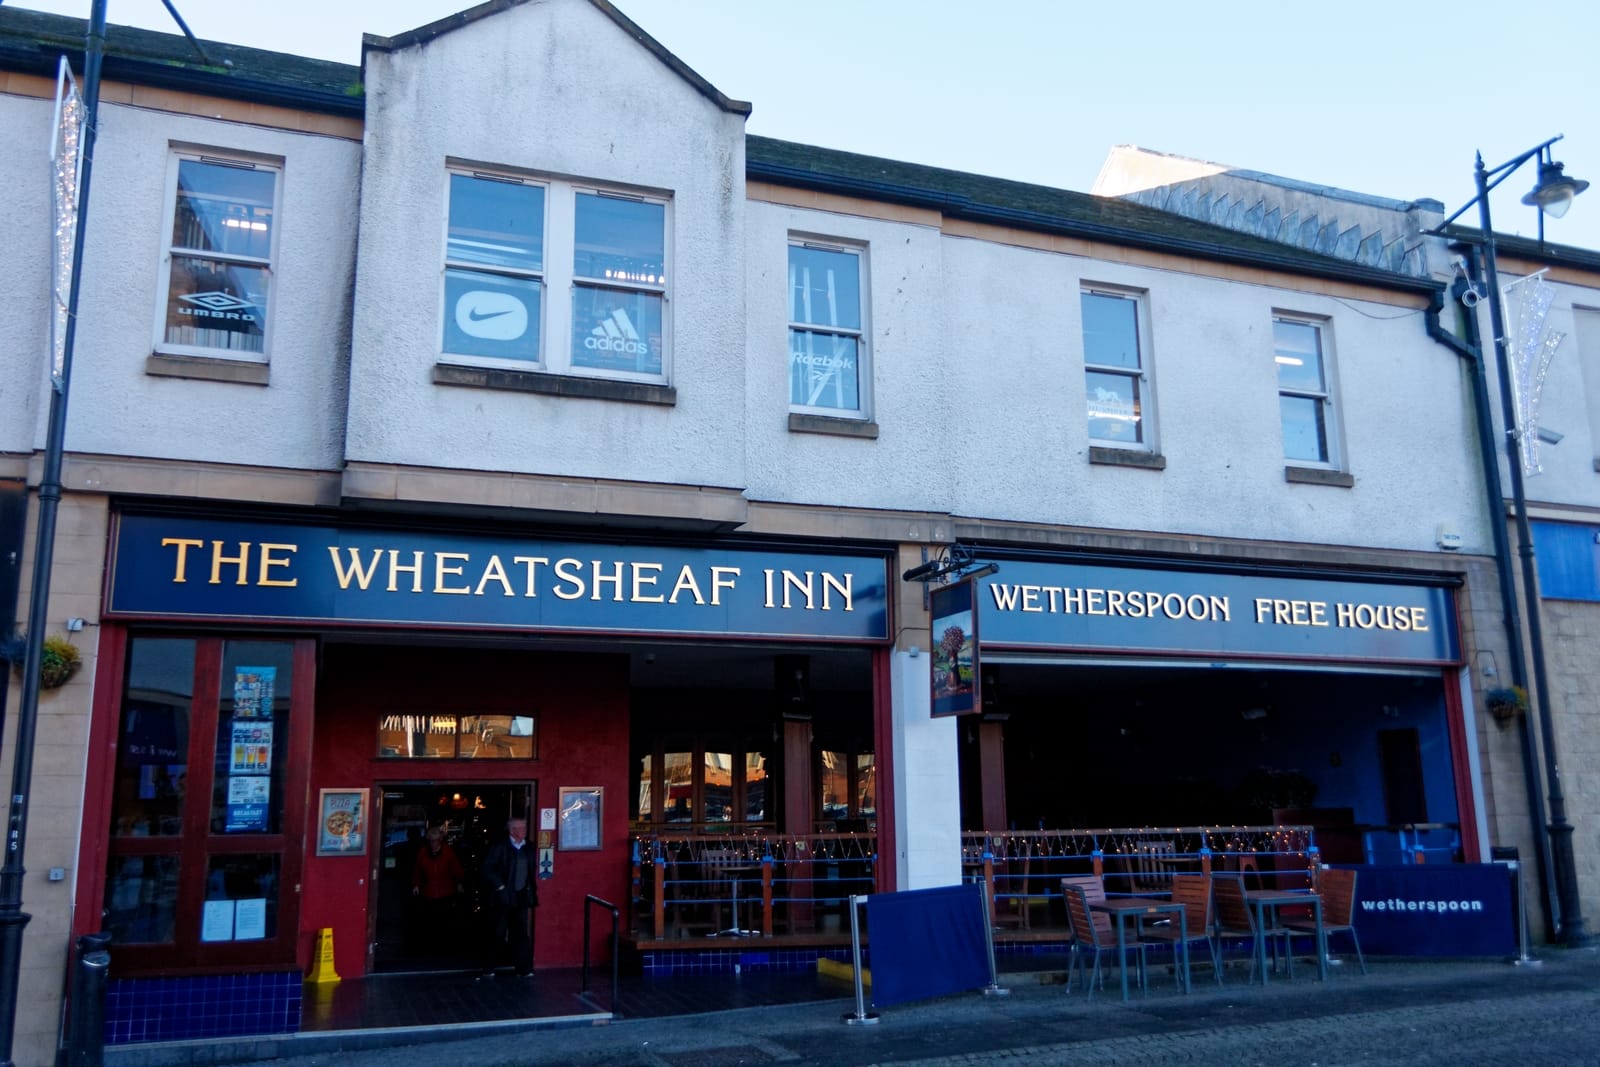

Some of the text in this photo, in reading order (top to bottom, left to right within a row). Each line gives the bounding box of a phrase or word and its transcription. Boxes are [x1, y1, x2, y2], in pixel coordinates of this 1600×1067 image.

[584, 336, 648, 354] adidas
[792, 352, 854, 369] Reebok
[162, 538, 854, 611] THE WHEATSHEAF INN
[990, 583, 1429, 631] WETHERSPOON FREE HOUSE
[1361, 898, 1483, 913] wetherspoon
